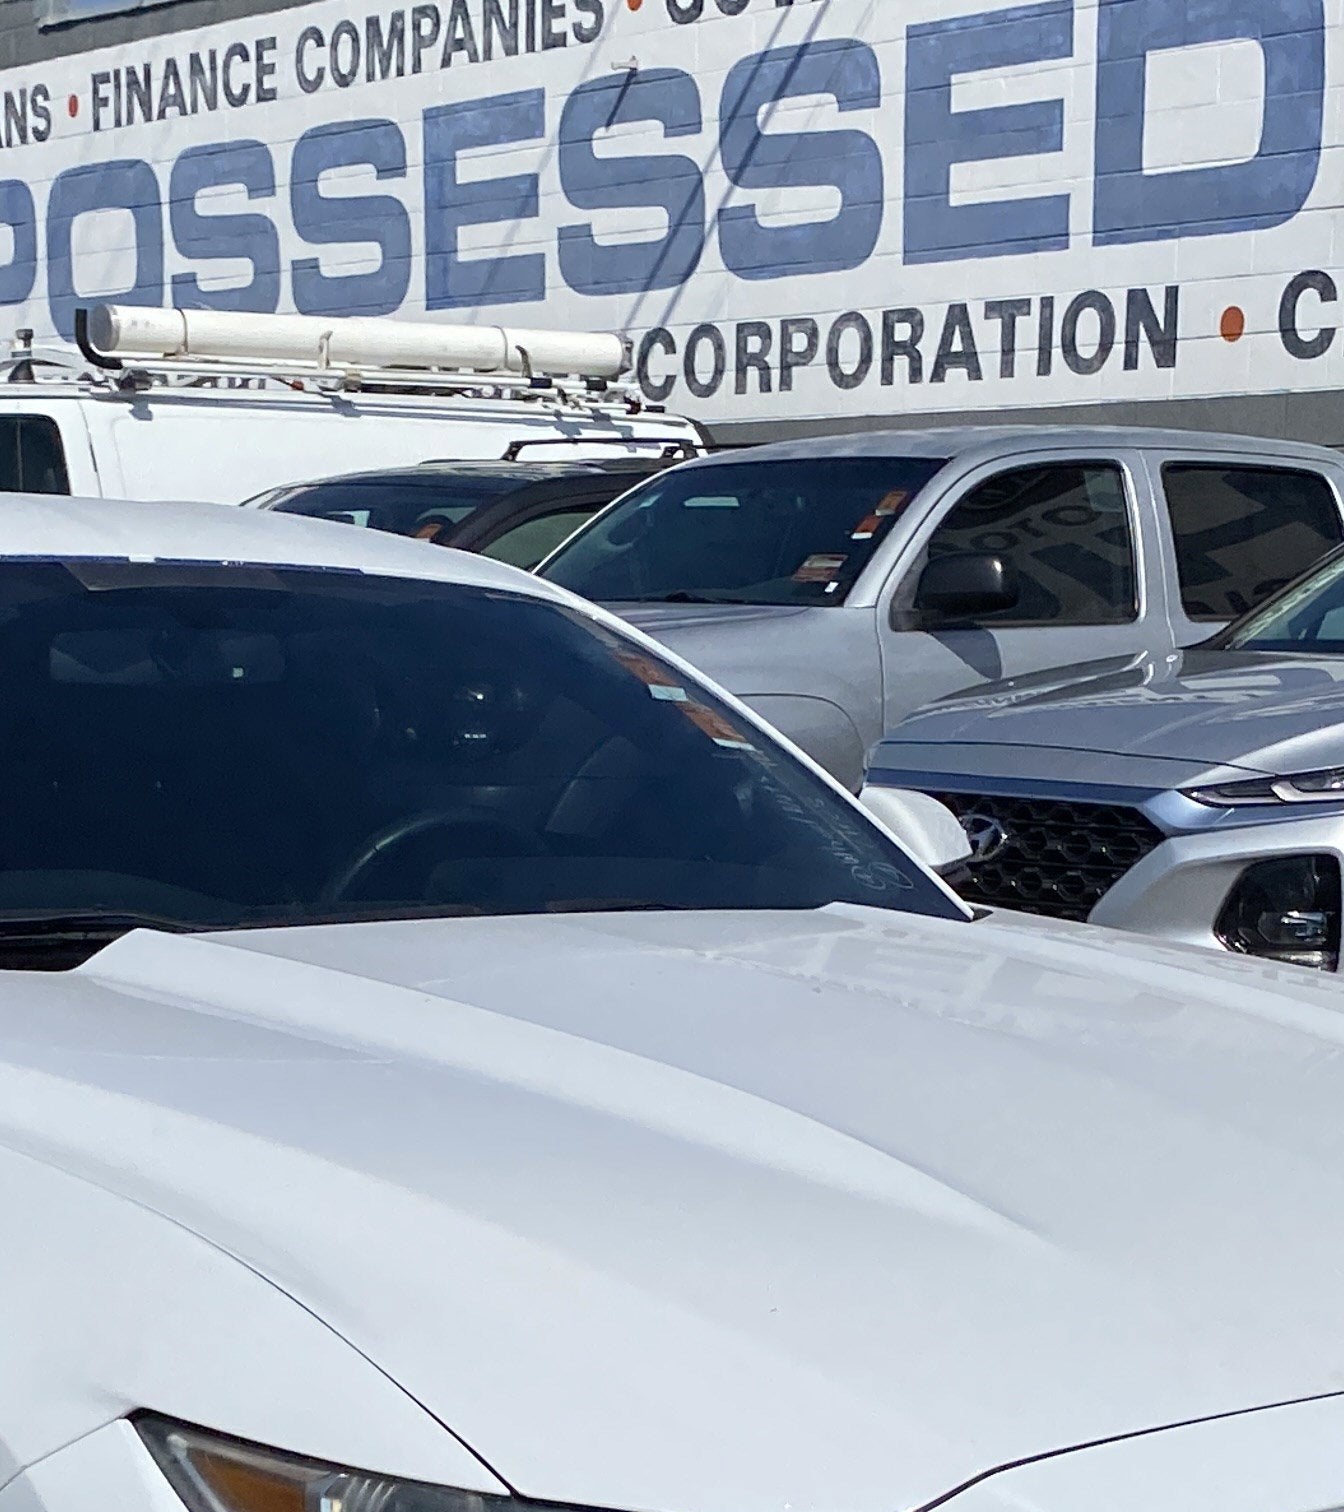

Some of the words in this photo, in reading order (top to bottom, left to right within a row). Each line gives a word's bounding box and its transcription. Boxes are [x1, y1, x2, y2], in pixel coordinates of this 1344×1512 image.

[91, 36, 277, 131] FINANCE
[295, 0, 604, 93] COMPANIES
[637, 285, 1179, 402] CORPORATION
